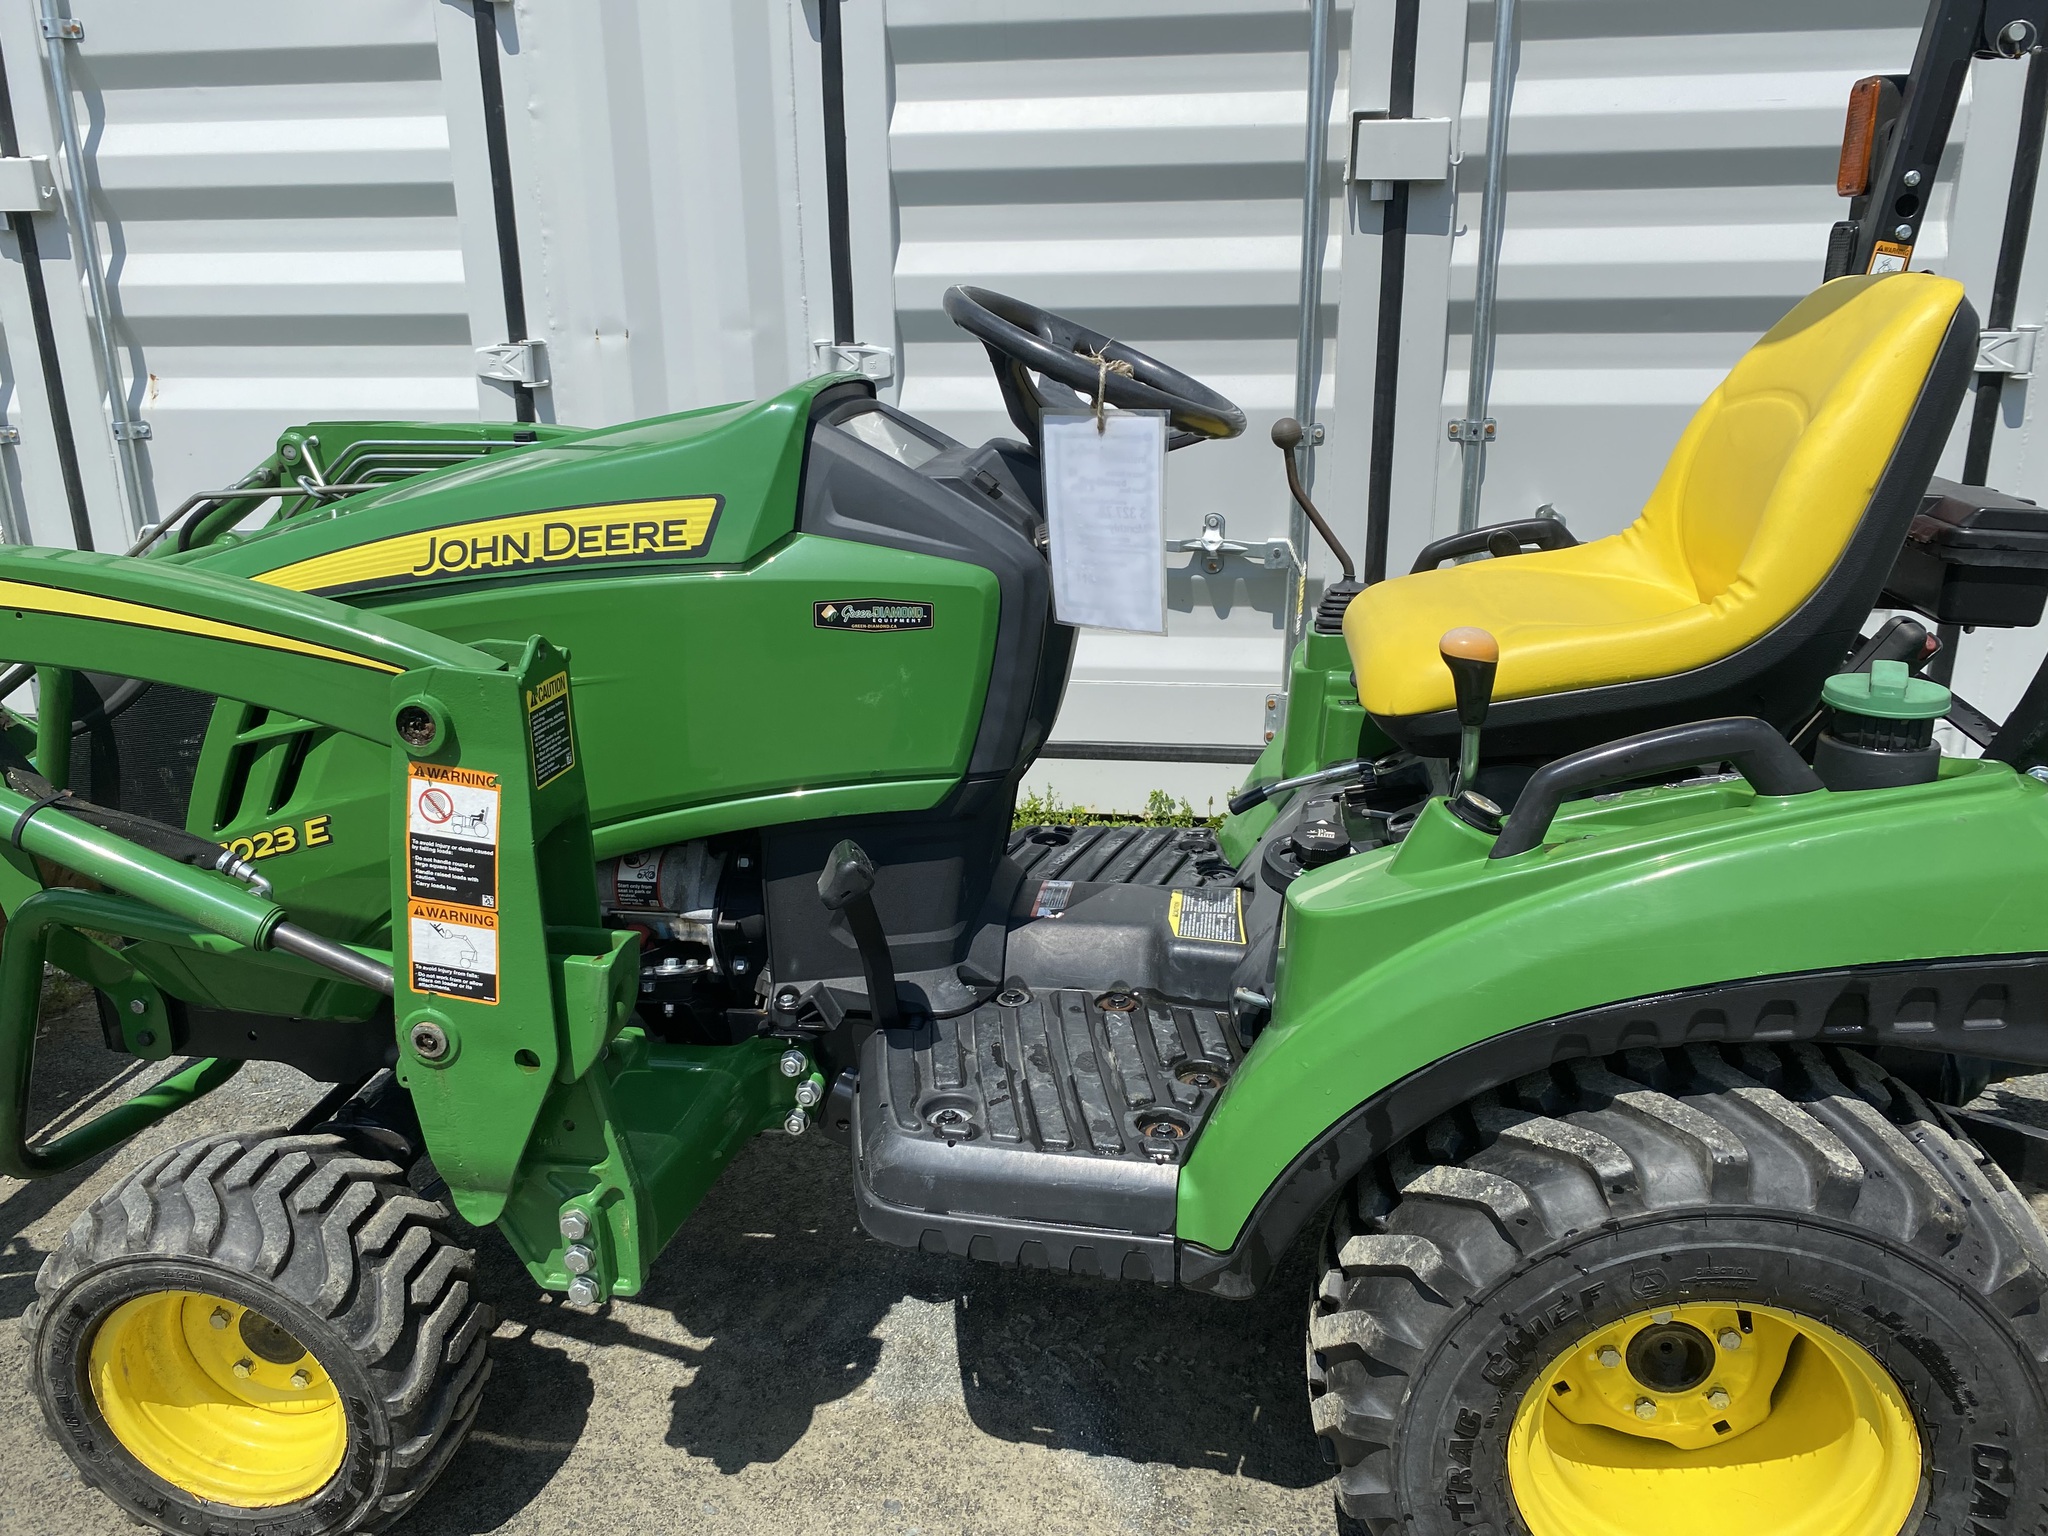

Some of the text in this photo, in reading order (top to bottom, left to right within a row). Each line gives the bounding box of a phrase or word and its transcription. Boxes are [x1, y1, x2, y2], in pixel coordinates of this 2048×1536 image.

[412, 519, 689, 574] JOHN DEERE
[538, 675, 566, 703] CAUTION
[427, 766, 497, 788] WARNING
[220, 814, 333, 862] 023 E
[420, 845, 436, 854] falling
[435, 842, 451, 850] injury
[474, 848, 494, 856] caused
[429, 863, 448, 871] square
[433, 857, 452, 865] handle
[415, 868, 433, 876] Handle
[451, 873, 467, 881] loads
[415, 880, 430, 888] Carry
[431, 882, 446, 890] loads
[426, 906, 494, 927] WARNING
[438, 966, 453, 975] injury
[418, 976, 434, 984] riders
[442, 980, 458, 988] loader
[1695, 1266, 1751, 1276] DIRECTION
[1445, 1281, 1606, 1521] TRAC CHIEF
